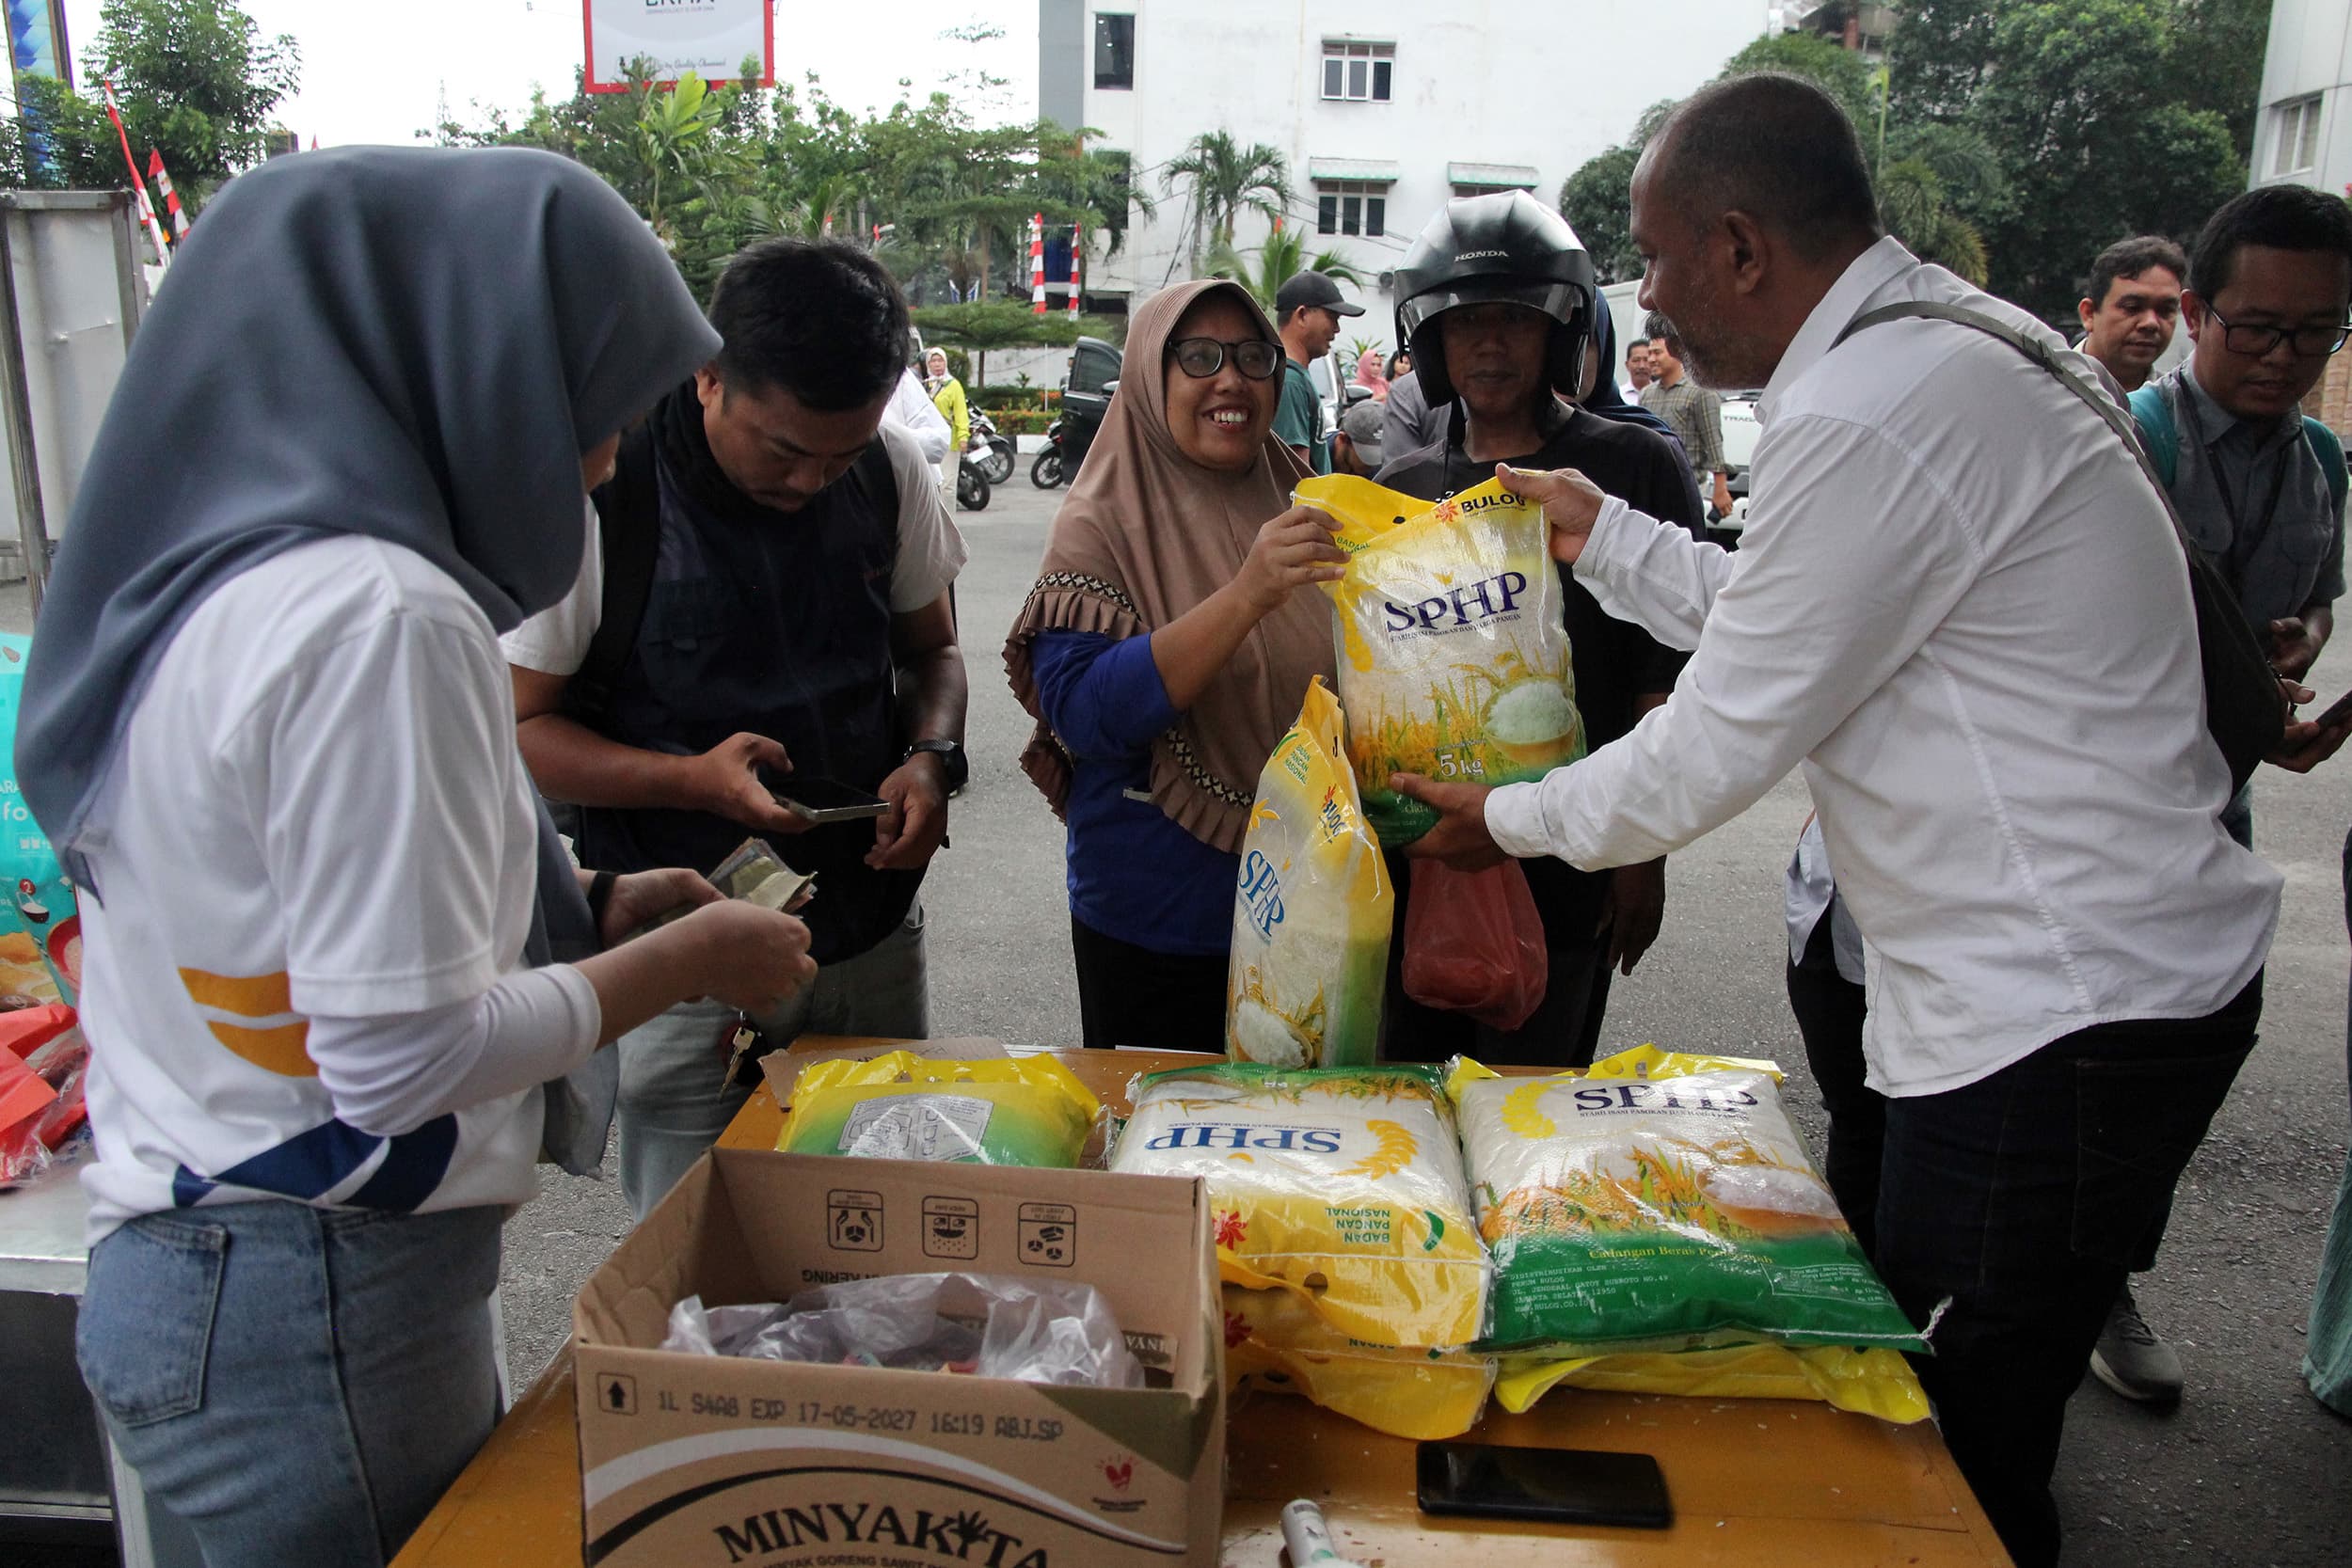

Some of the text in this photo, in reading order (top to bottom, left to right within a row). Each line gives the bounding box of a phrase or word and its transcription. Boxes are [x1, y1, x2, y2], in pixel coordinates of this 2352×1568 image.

[1454, 249, 1509, 262] HONDA
[1461, 494, 1526, 514] BULOG
[1385, 571, 1527, 633] SPHP
[1439, 754, 1485, 777] 5 kg
[1238, 849, 1285, 939] SPHP
[1144, 1127, 1341, 1153] SPHP
[1325, 1207, 1391, 1218] NASIONAL
[1336, 1219, 1391, 1230] PANGAN
[1343, 1232, 1390, 1243] BADAN
[1588, 1246, 1656, 1259] Cadangan
[1659, 1245, 1694, 1257] Beras
[1540, 1276, 1565, 1285] BULOG
[660, 1389, 680, 1412] 1L
[751, 1398, 787, 1420] EXP
[797, 1401, 917, 1432] 17-05-2027
[930, 1412, 985, 1436] 16:19
[816, 1555, 877, 1567] GORENG
